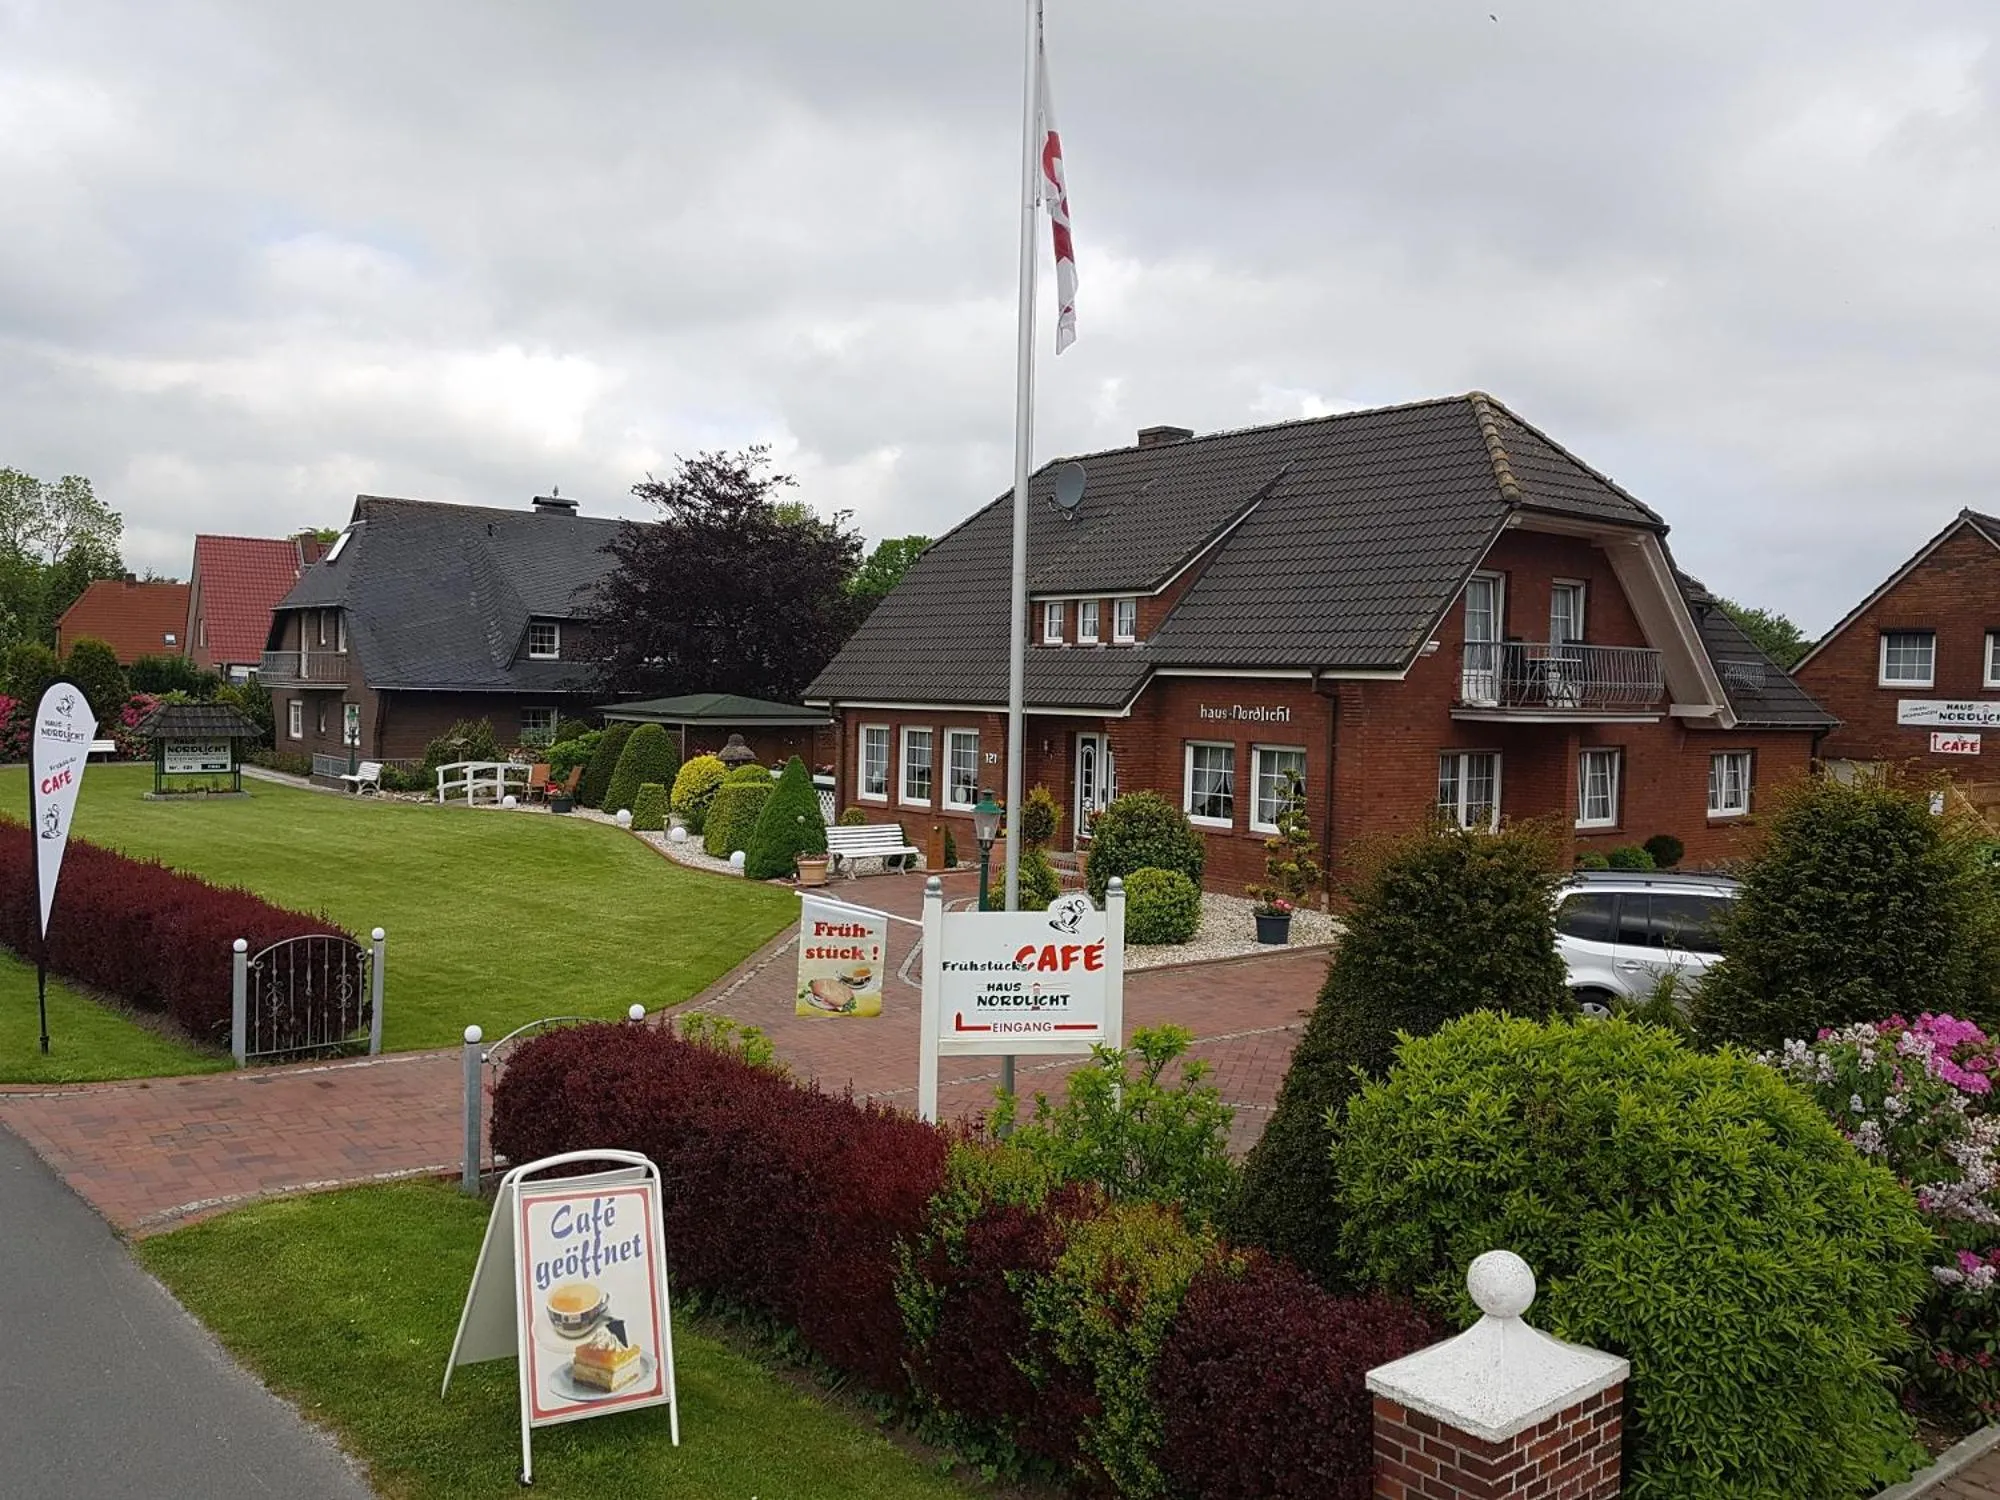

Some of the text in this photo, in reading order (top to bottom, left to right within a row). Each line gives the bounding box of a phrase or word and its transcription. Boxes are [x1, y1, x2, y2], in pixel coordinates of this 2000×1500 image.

[41, 728, 85, 741] NORDLICHT
[985, 752, 997, 764] 121
[814, 921, 874, 938] Früh-
[805, 945, 866, 960] stück
[1015, 937, 1105, 972] CAFÉ
[987, 983, 1022, 992] HAUS
[977, 995, 1071, 1006] NORDLICHT
[993, 1022, 1052, 1033] EINGANG
[551, 1197, 616, 1240] Café
[535, 1234, 643, 1290] geöffnet
